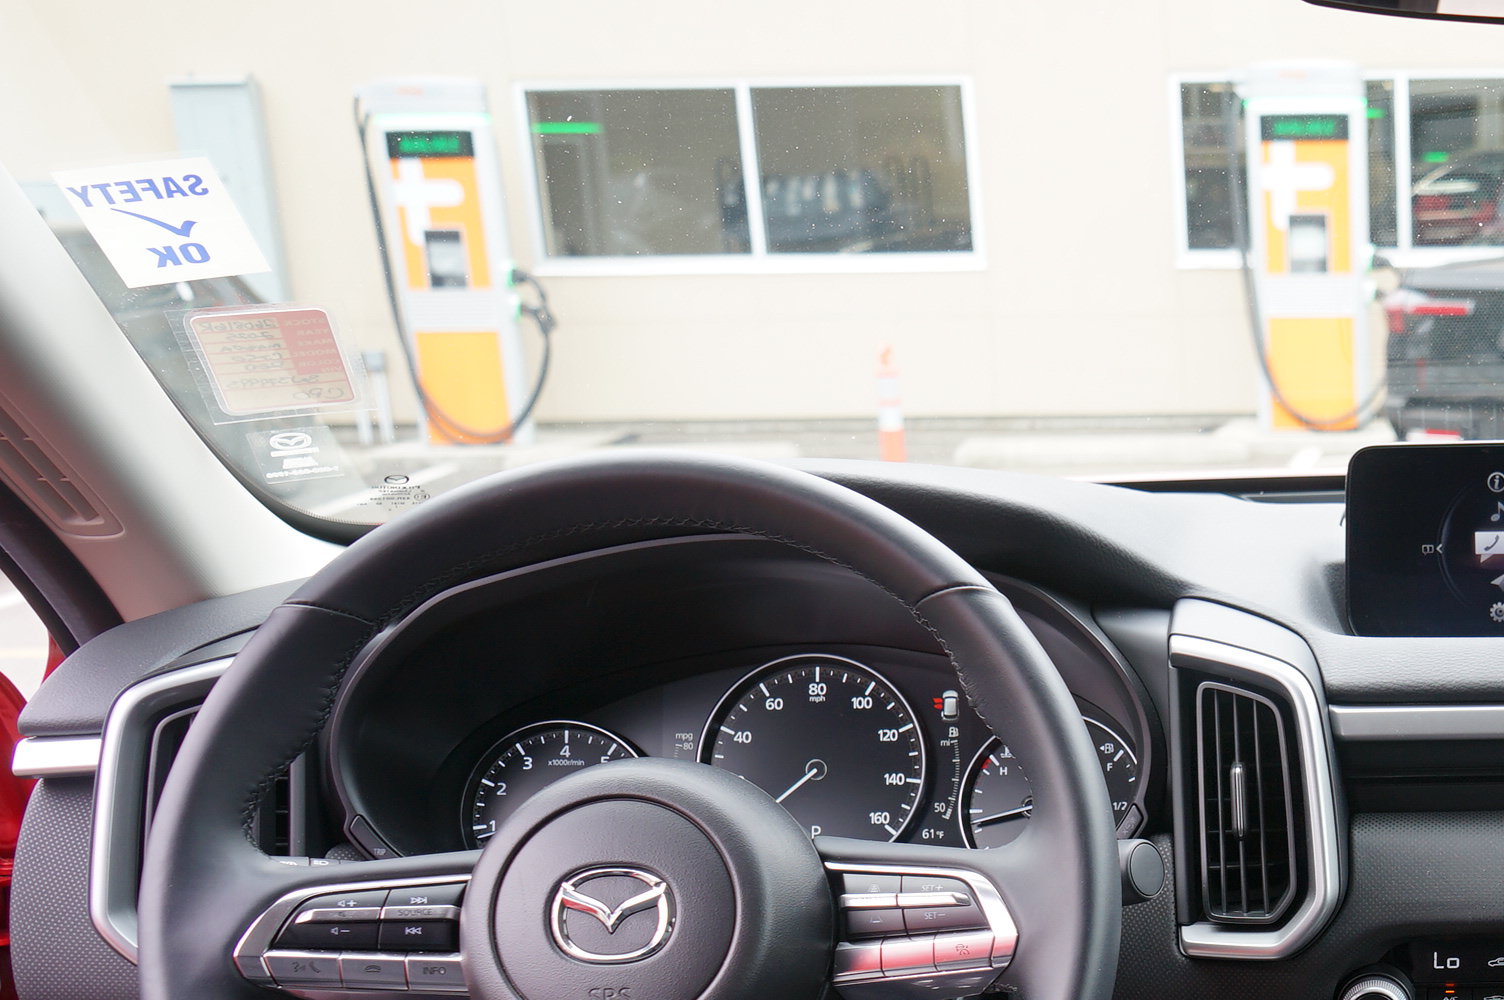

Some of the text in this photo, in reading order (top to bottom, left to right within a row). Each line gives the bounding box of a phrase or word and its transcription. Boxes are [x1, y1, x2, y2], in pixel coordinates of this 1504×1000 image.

[808, 683, 827, 696] 80
[765, 698, 784, 711] 60
[809, 695, 826, 703] mph
[851, 697, 873, 710] 100
[675, 732, 694, 742] mpg
[733, 731, 752, 744] 40
[877, 729, 899, 742] 120
[683, 742, 694, 751] 80
[940, 738, 951, 747] mi
[559, 745, 571, 758] 4
[522, 756, 533, 770] 3
[1106, 763, 1113, 772] F
[999, 766, 1008, 776] H
[884, 773, 906, 786] 140
[496, 782, 507, 796] 2
[934, 803, 946, 813] 50
[1112, 801, 1128, 811] 1/2
[869, 812, 890, 825] 160
[489, 820, 496, 832] 1
[811, 826, 822, 839] P
[1433, 951, 1460, 969] Lo
[422, 967, 447, 976] INFO
